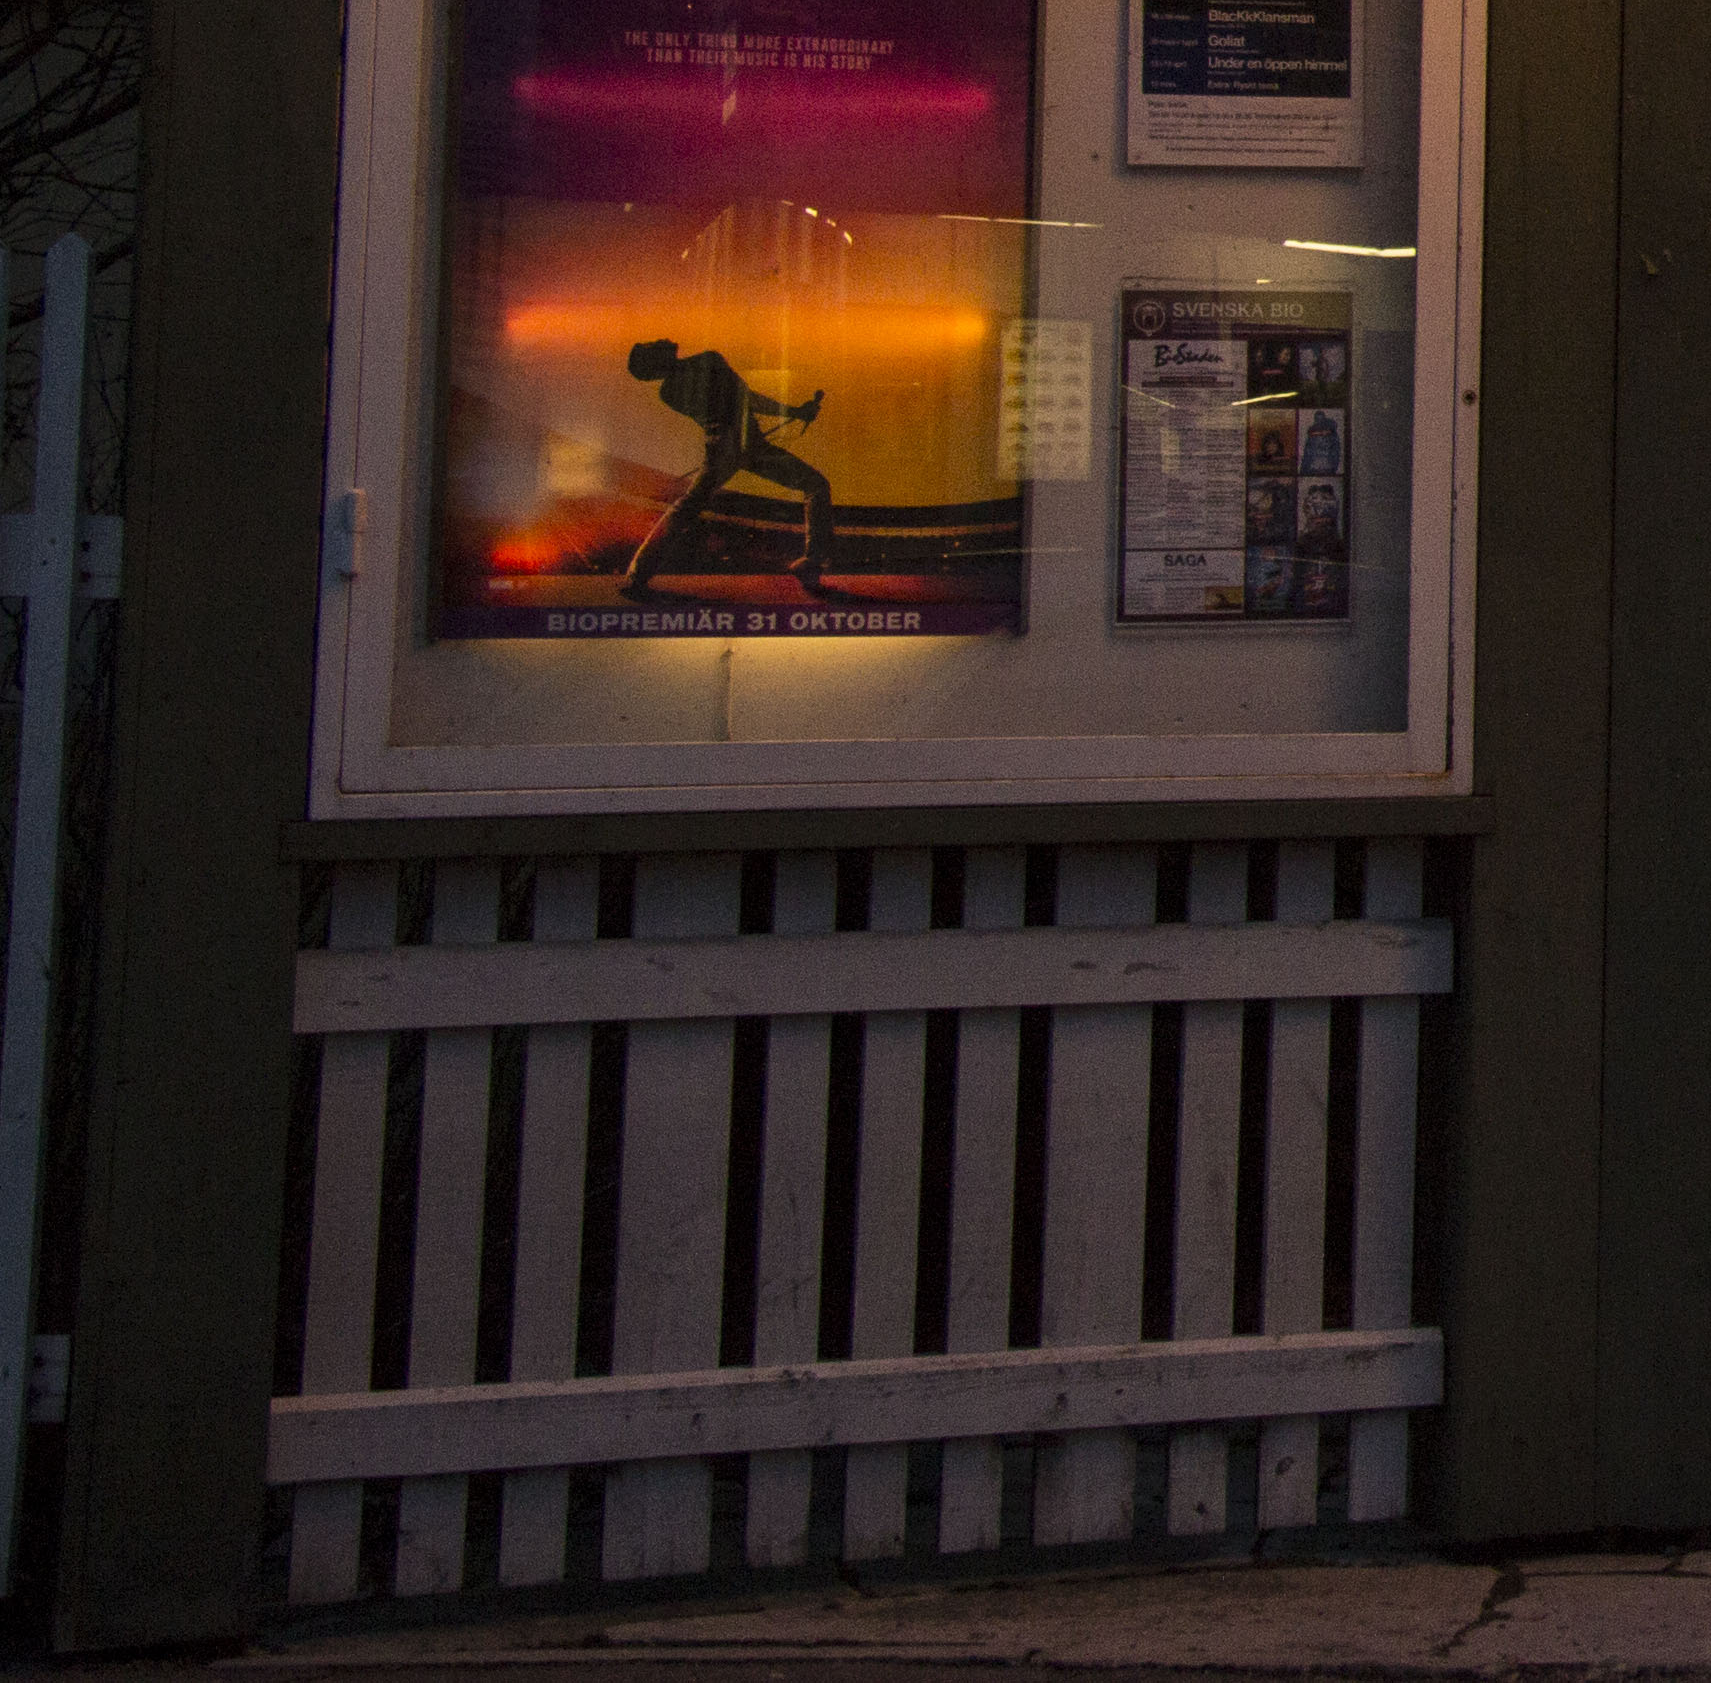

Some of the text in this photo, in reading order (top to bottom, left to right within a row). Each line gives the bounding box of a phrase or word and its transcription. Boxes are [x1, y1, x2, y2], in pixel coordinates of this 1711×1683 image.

[624, 30, 648, 46] THE
[654, 31, 690, 47] ONLY
[697, 32, 737, 49] THING
[743, 34, 782, 50] MORE
[1207, 33, 1246, 47] Goliat
[646, 48, 683, 64] THAN
[733, 51, 779, 67] MUSIC
[783, 53, 797, 67] IS
[802, 53, 826, 69] HIS
[831, 54, 872, 70] STORY
[1207, 56, 1347, 72] Under en öppen himmel
[1172, 302, 1304, 319] SVENSKA BIO
[1164, 554, 1207, 567] SAGA
[547, 608, 921, 631] BIOPREMIÄR 31 OKTOBER
